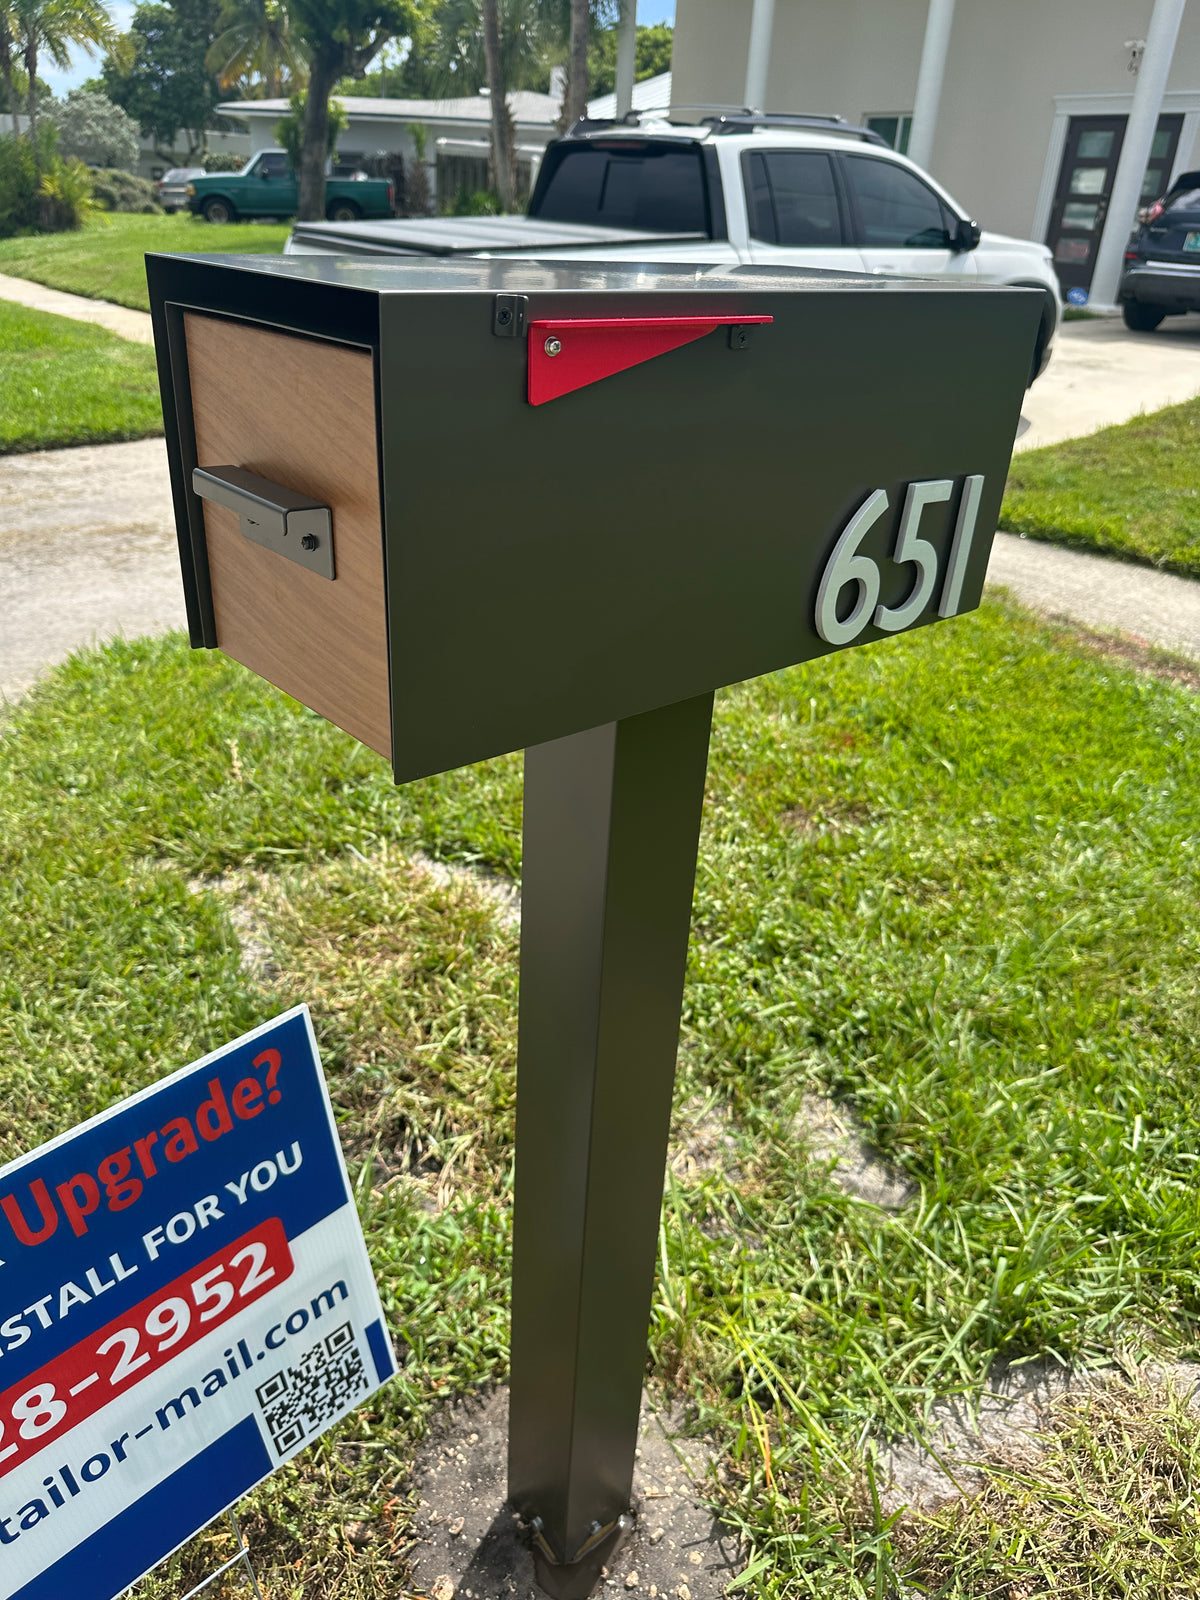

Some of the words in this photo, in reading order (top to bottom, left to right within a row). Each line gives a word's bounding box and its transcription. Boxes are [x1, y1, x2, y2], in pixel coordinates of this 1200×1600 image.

[815, 474, 985, 645] 651
[0, 1048, 283, 1247] Upgrade?
[0, 1252, 138, 1358] STALL
[143, 1195, 225, 1262] FOR
[225, 1140, 303, 1205] YOU
[0, 1279, 349, 1545] tailor-mail.com
